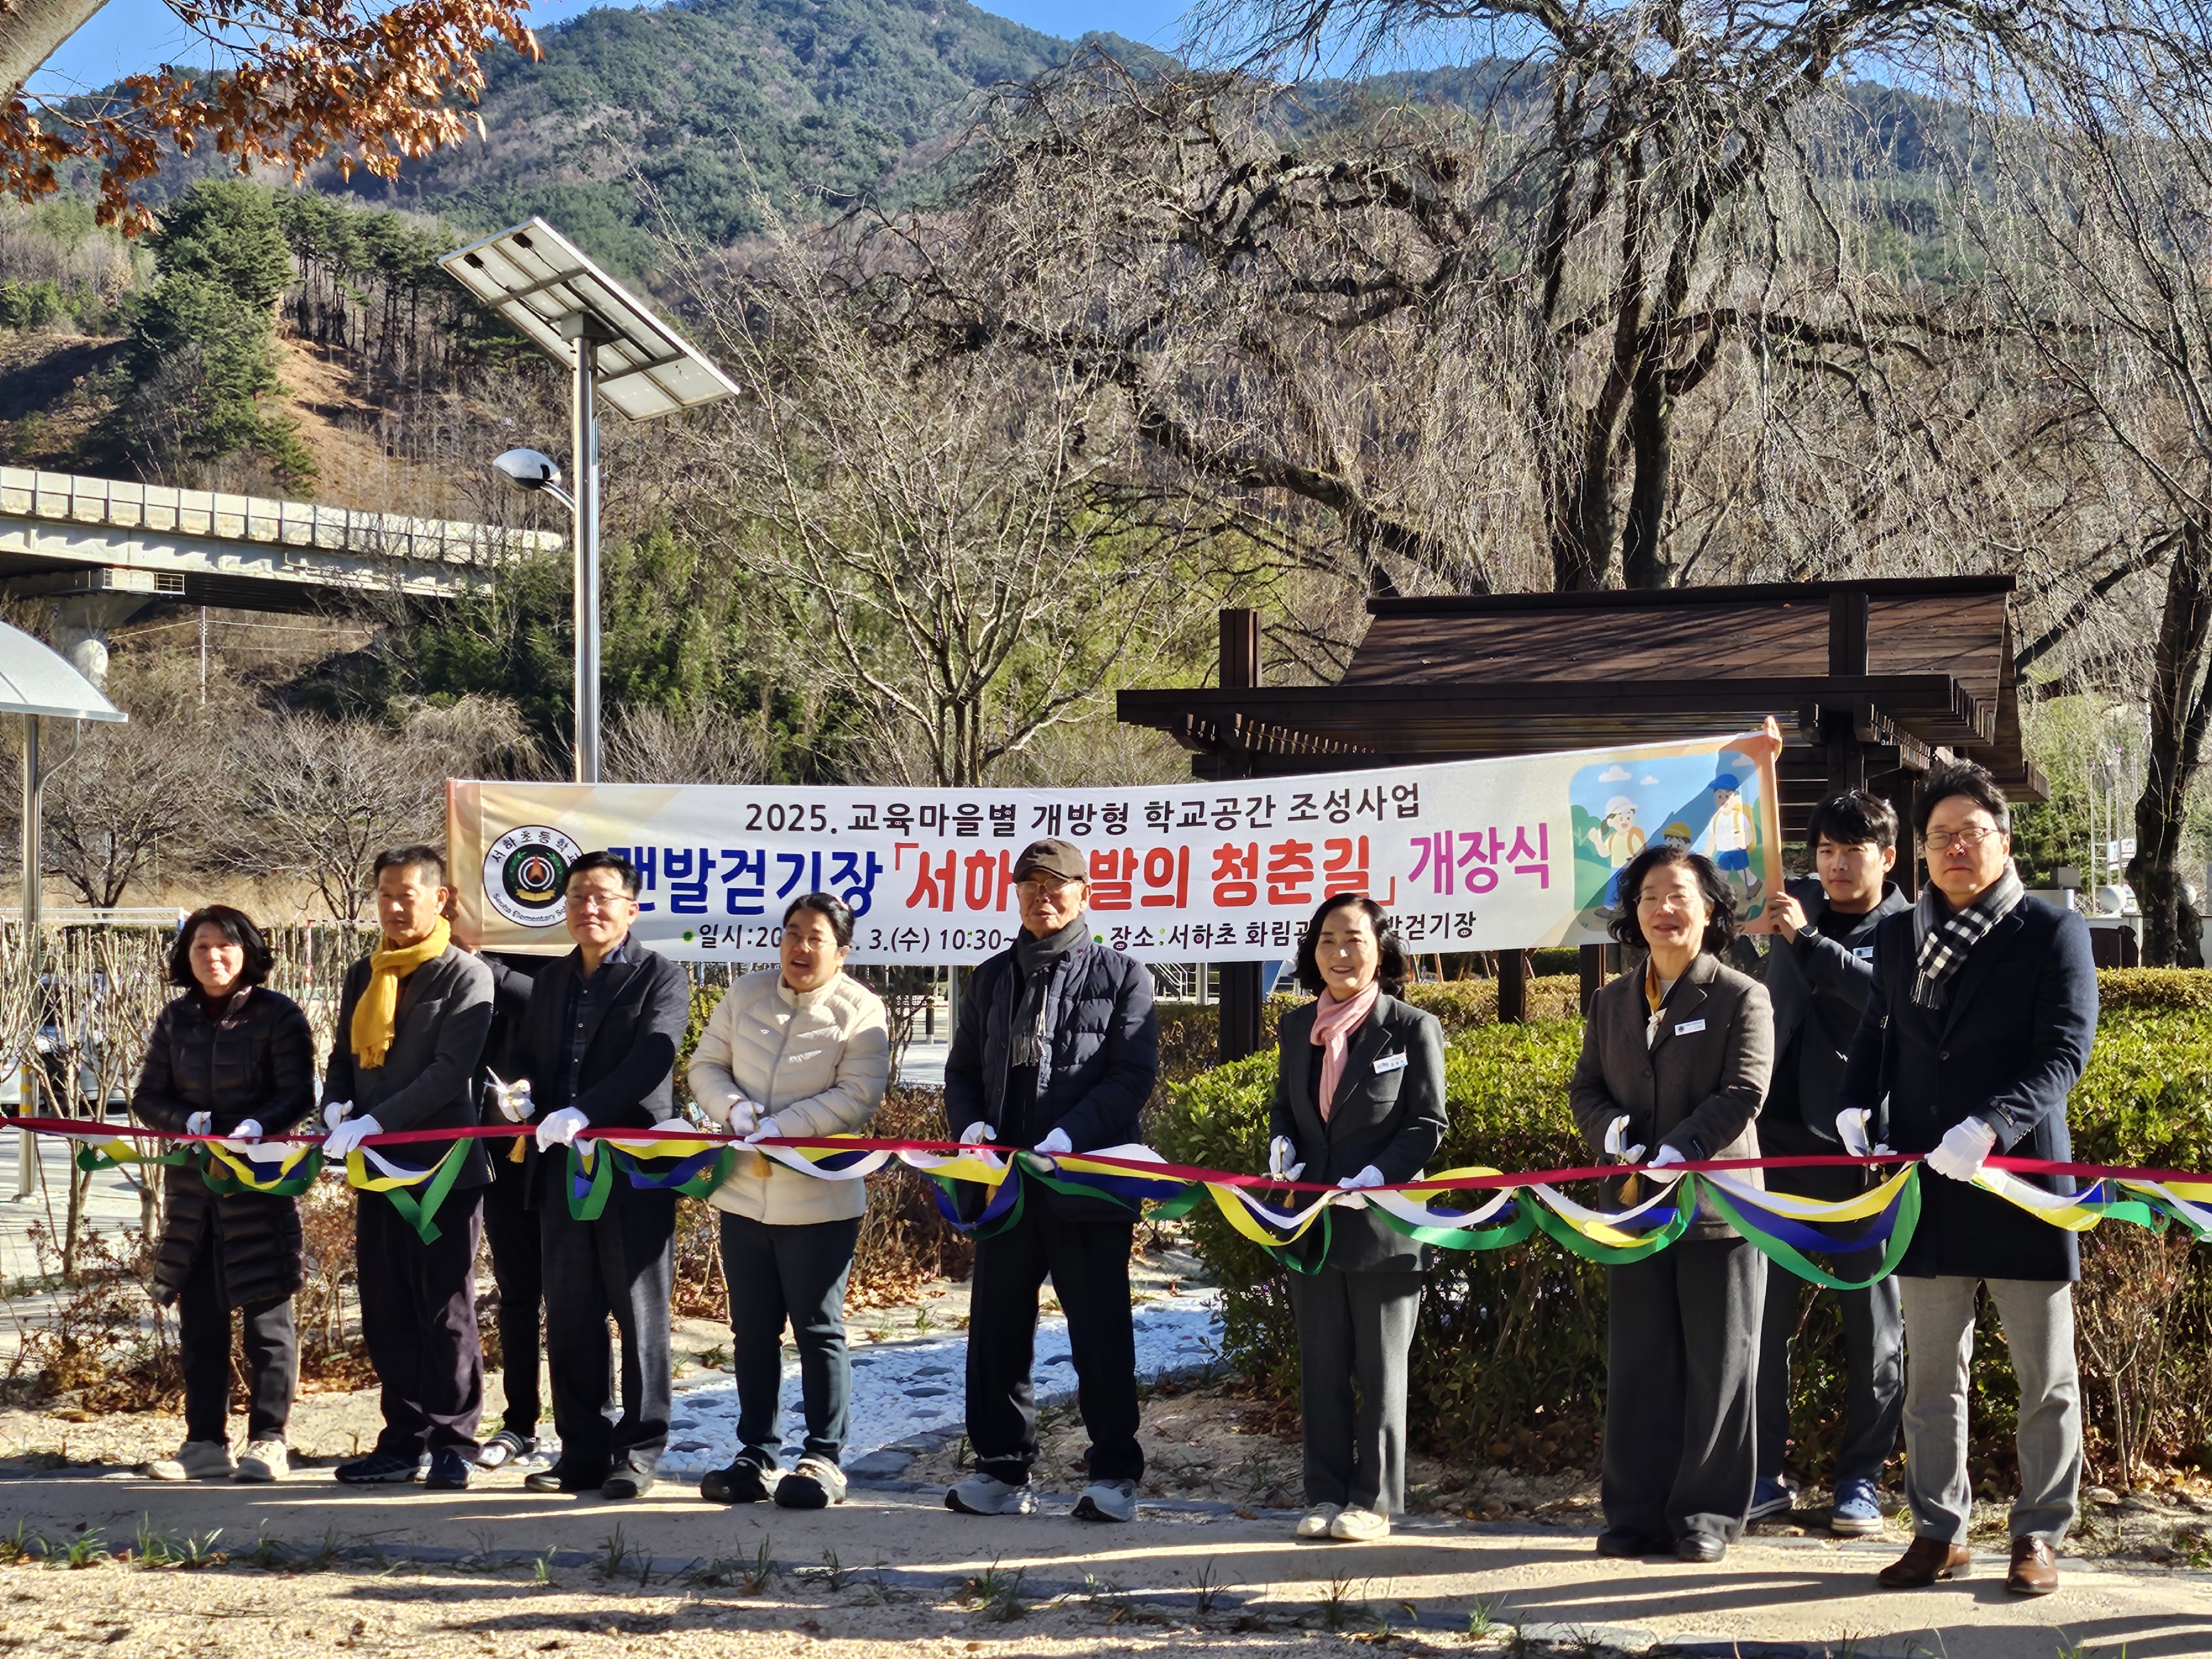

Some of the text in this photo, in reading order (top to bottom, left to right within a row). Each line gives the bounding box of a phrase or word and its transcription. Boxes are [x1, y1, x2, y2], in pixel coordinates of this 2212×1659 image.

[745, 782, 1420, 837] 2025. 교육마을별 개방형 학교공간 조성사업
[1408, 823, 1549, 895] 개장식
